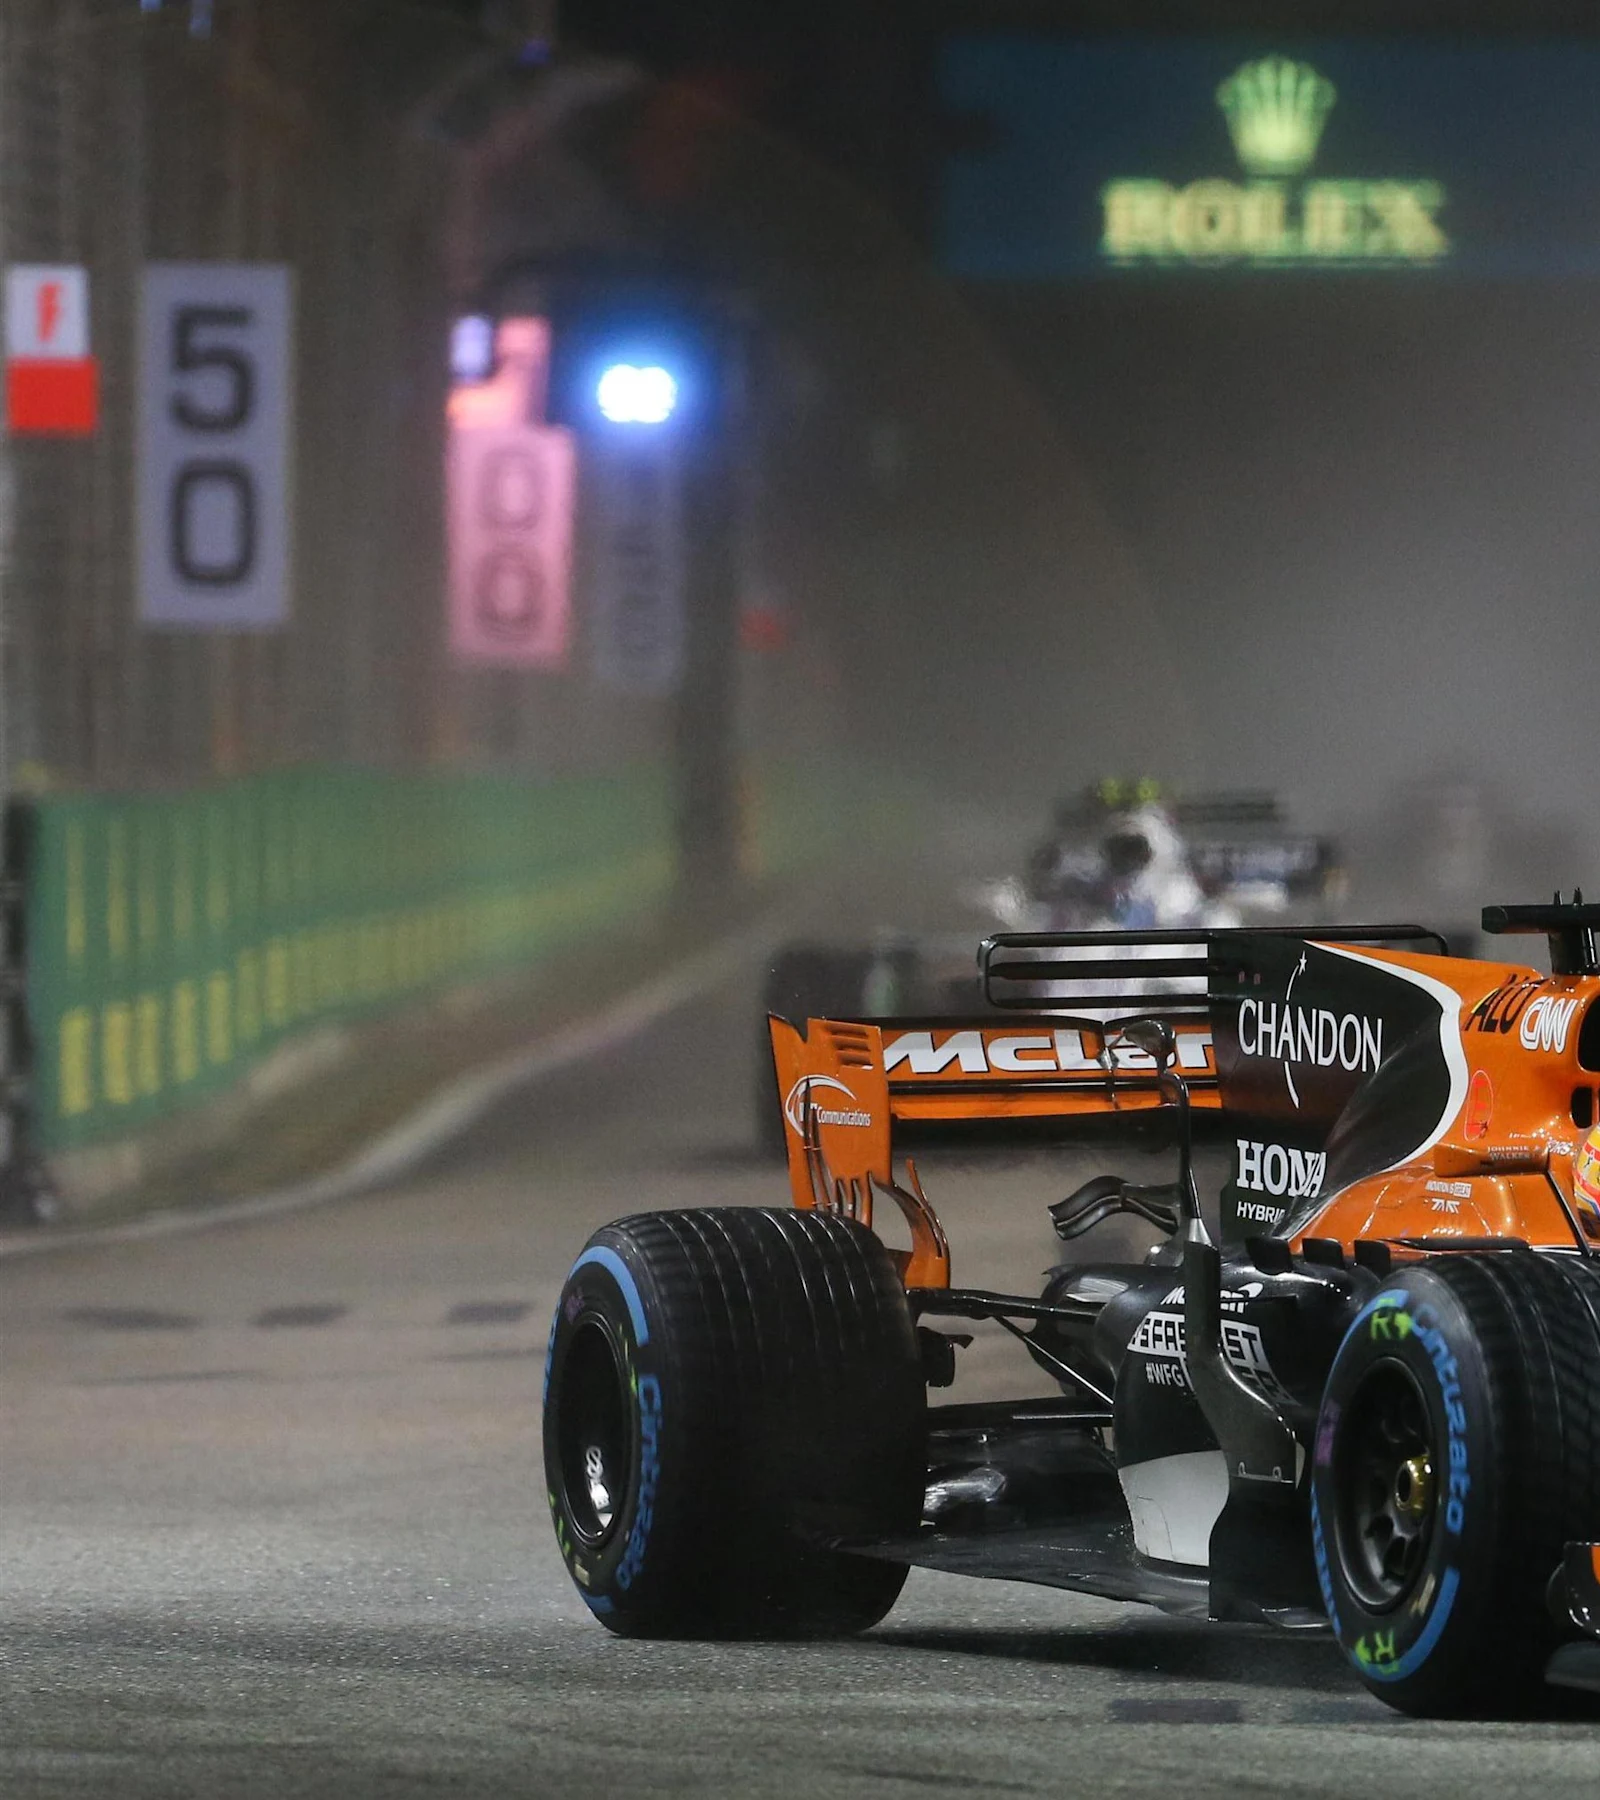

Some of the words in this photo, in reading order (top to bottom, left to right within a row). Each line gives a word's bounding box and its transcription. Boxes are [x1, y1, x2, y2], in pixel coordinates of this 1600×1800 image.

[1102, 178, 1449, 266] ROLEX
[168, 304, 258, 590] 50
[1238, 999, 1383, 1074] CHANDON
[1520, 996, 1578, 1054] CNN
[817, 1106, 871, 1127] Communications
